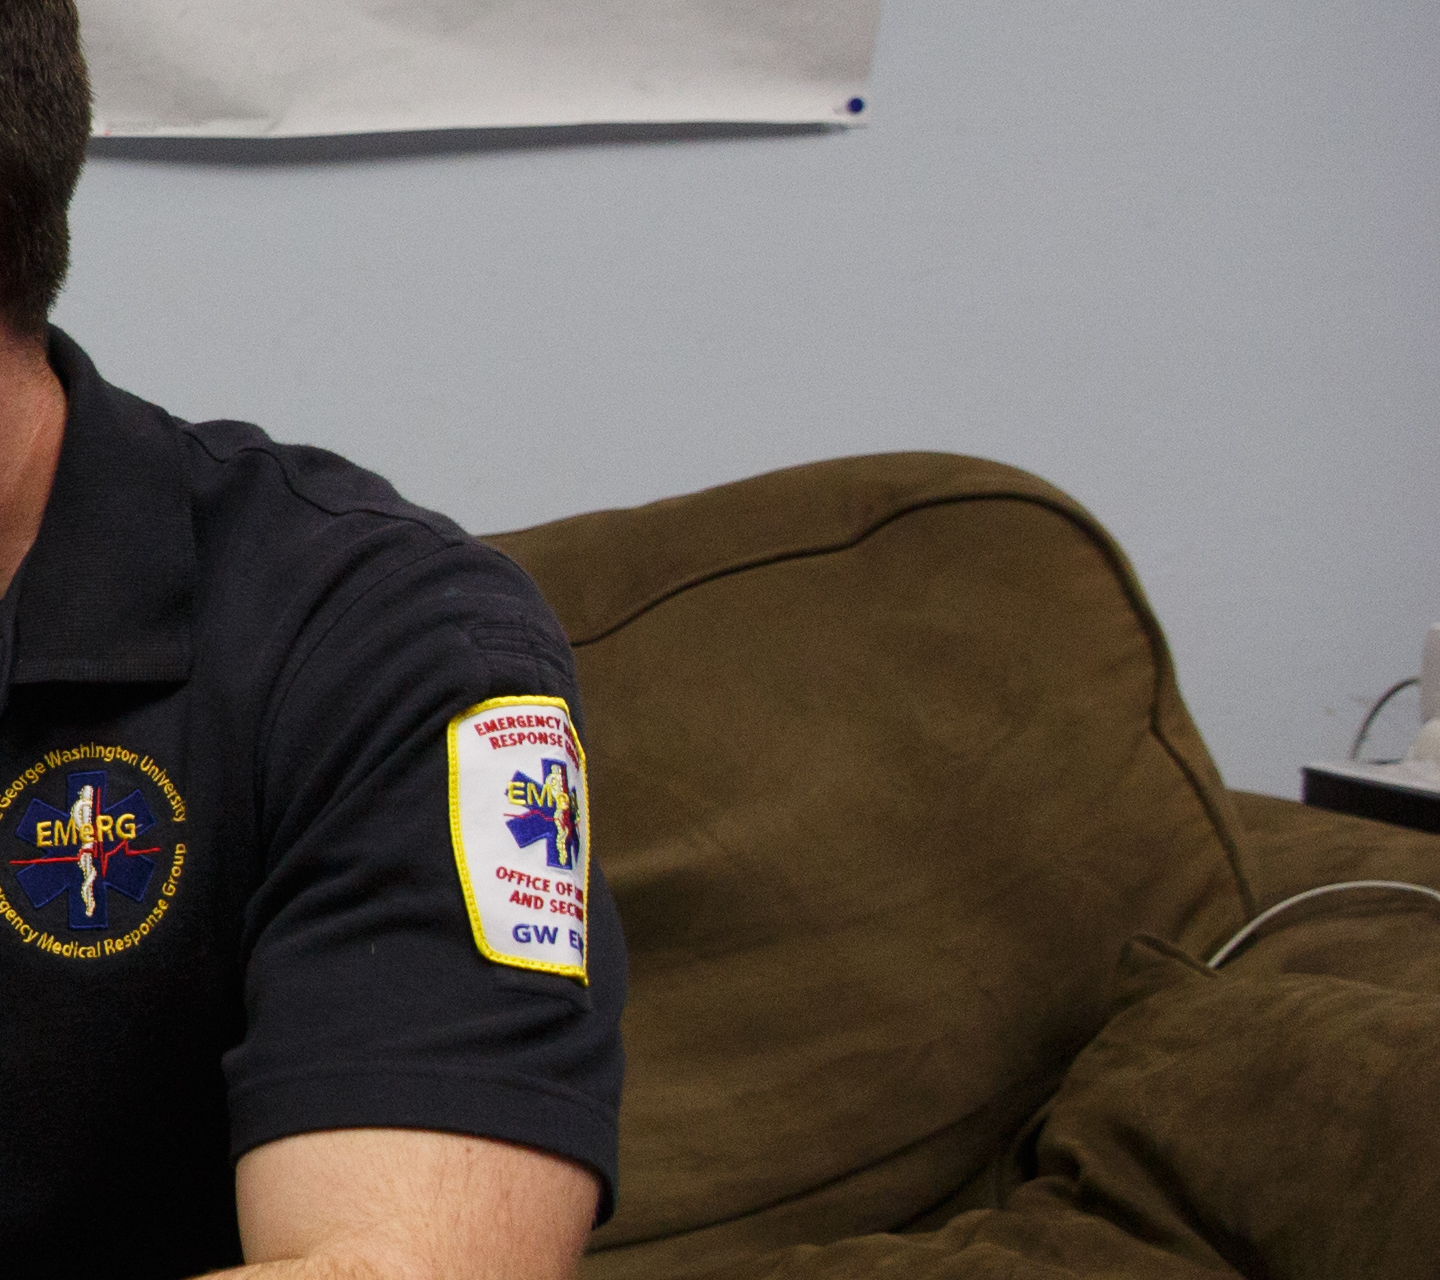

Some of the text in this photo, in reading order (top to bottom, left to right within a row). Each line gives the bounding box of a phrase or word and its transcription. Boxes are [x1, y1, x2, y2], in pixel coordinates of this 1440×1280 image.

[473, 714, 562, 738] EMERGENCY
[488, 730, 565, 751] RESPONSE
[43, 741, 140, 769] Washington
[139, 754, 188, 824] University
[35, 812, 138, 848] EMeRG
[495, 865, 551, 894] OFFICE
[554, 880, 573, 898] OF
[35, 931, 102, 959] Medical
[103, 898, 170, 957] Response
[161, 842, 188, 898] Group
[508, 888, 545, 911] AND
[512, 923, 559, 946] GW
